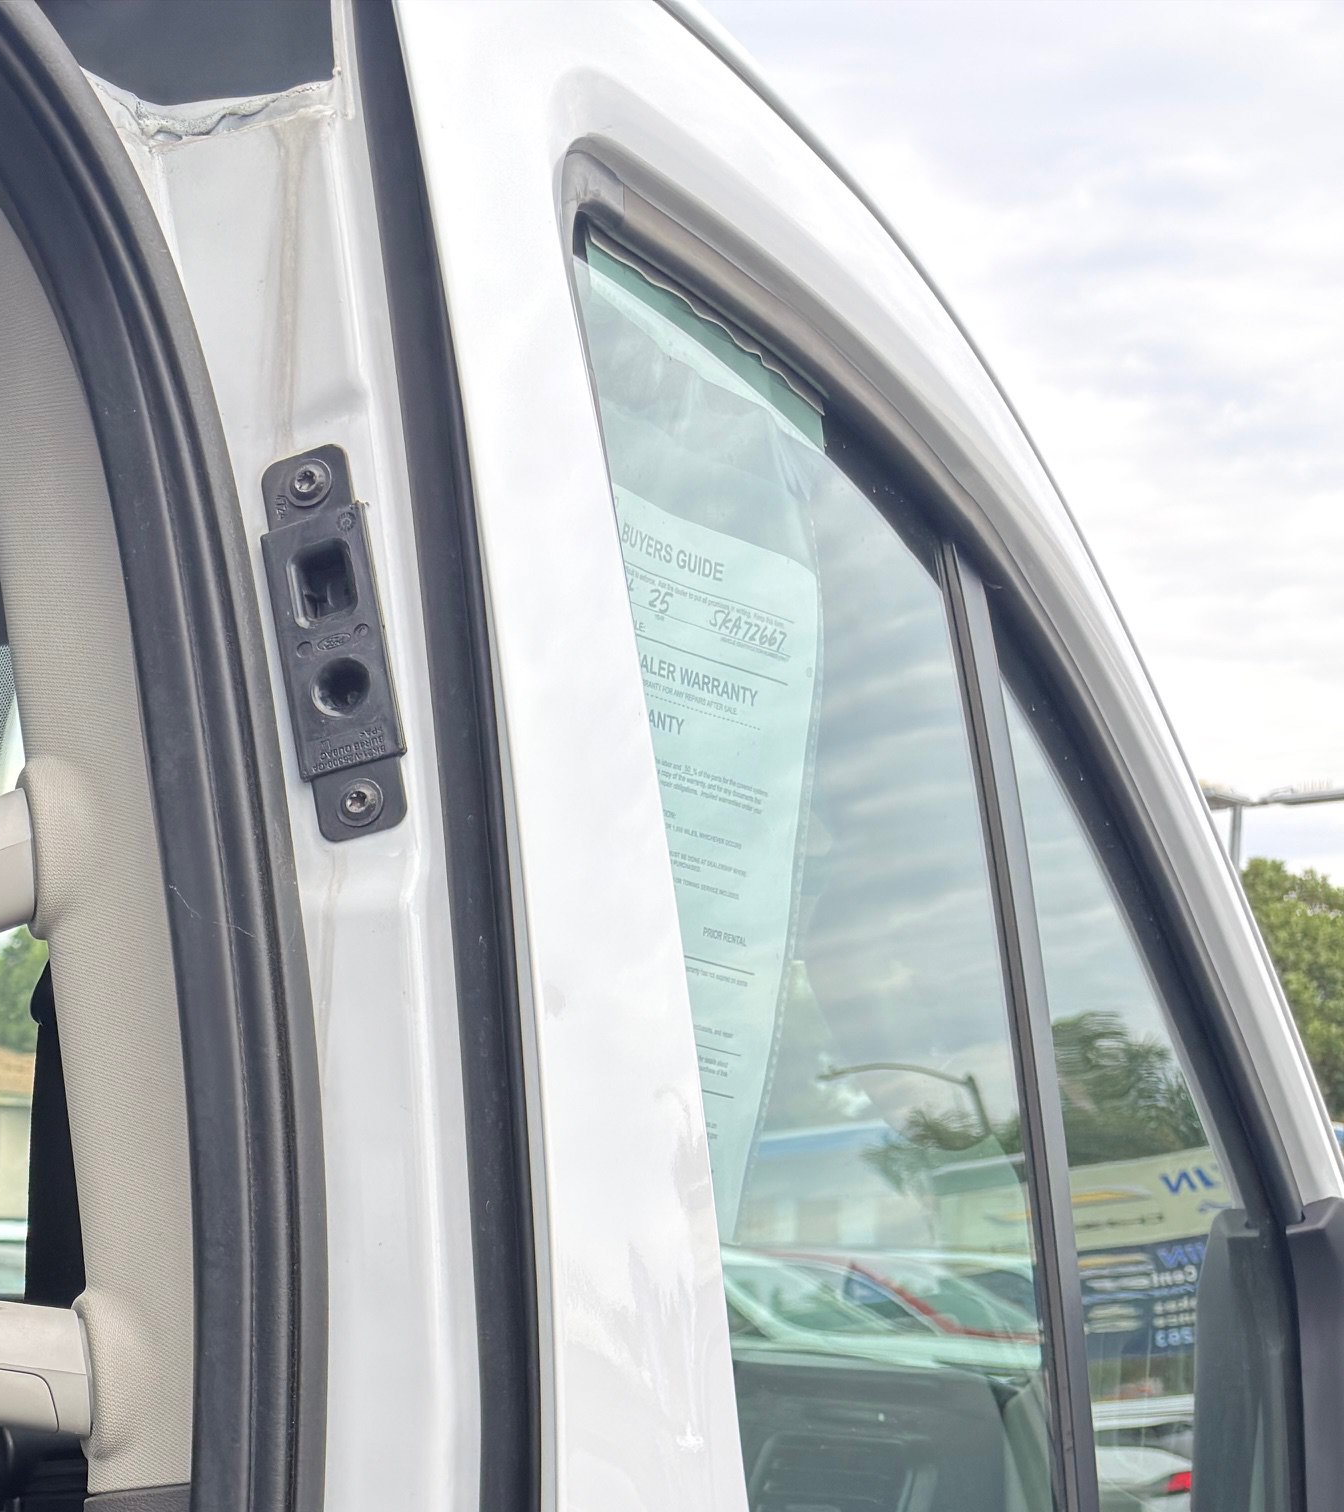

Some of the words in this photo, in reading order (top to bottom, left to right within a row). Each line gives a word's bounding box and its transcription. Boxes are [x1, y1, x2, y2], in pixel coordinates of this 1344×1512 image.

[621, 521, 674, 564] BUYERS
[676, 549, 725, 582] GUIDE
[647, 588, 674, 615] 25
[679, 666, 758, 707] WARRANTY
[702, 926, 723, 941] PRIOR
